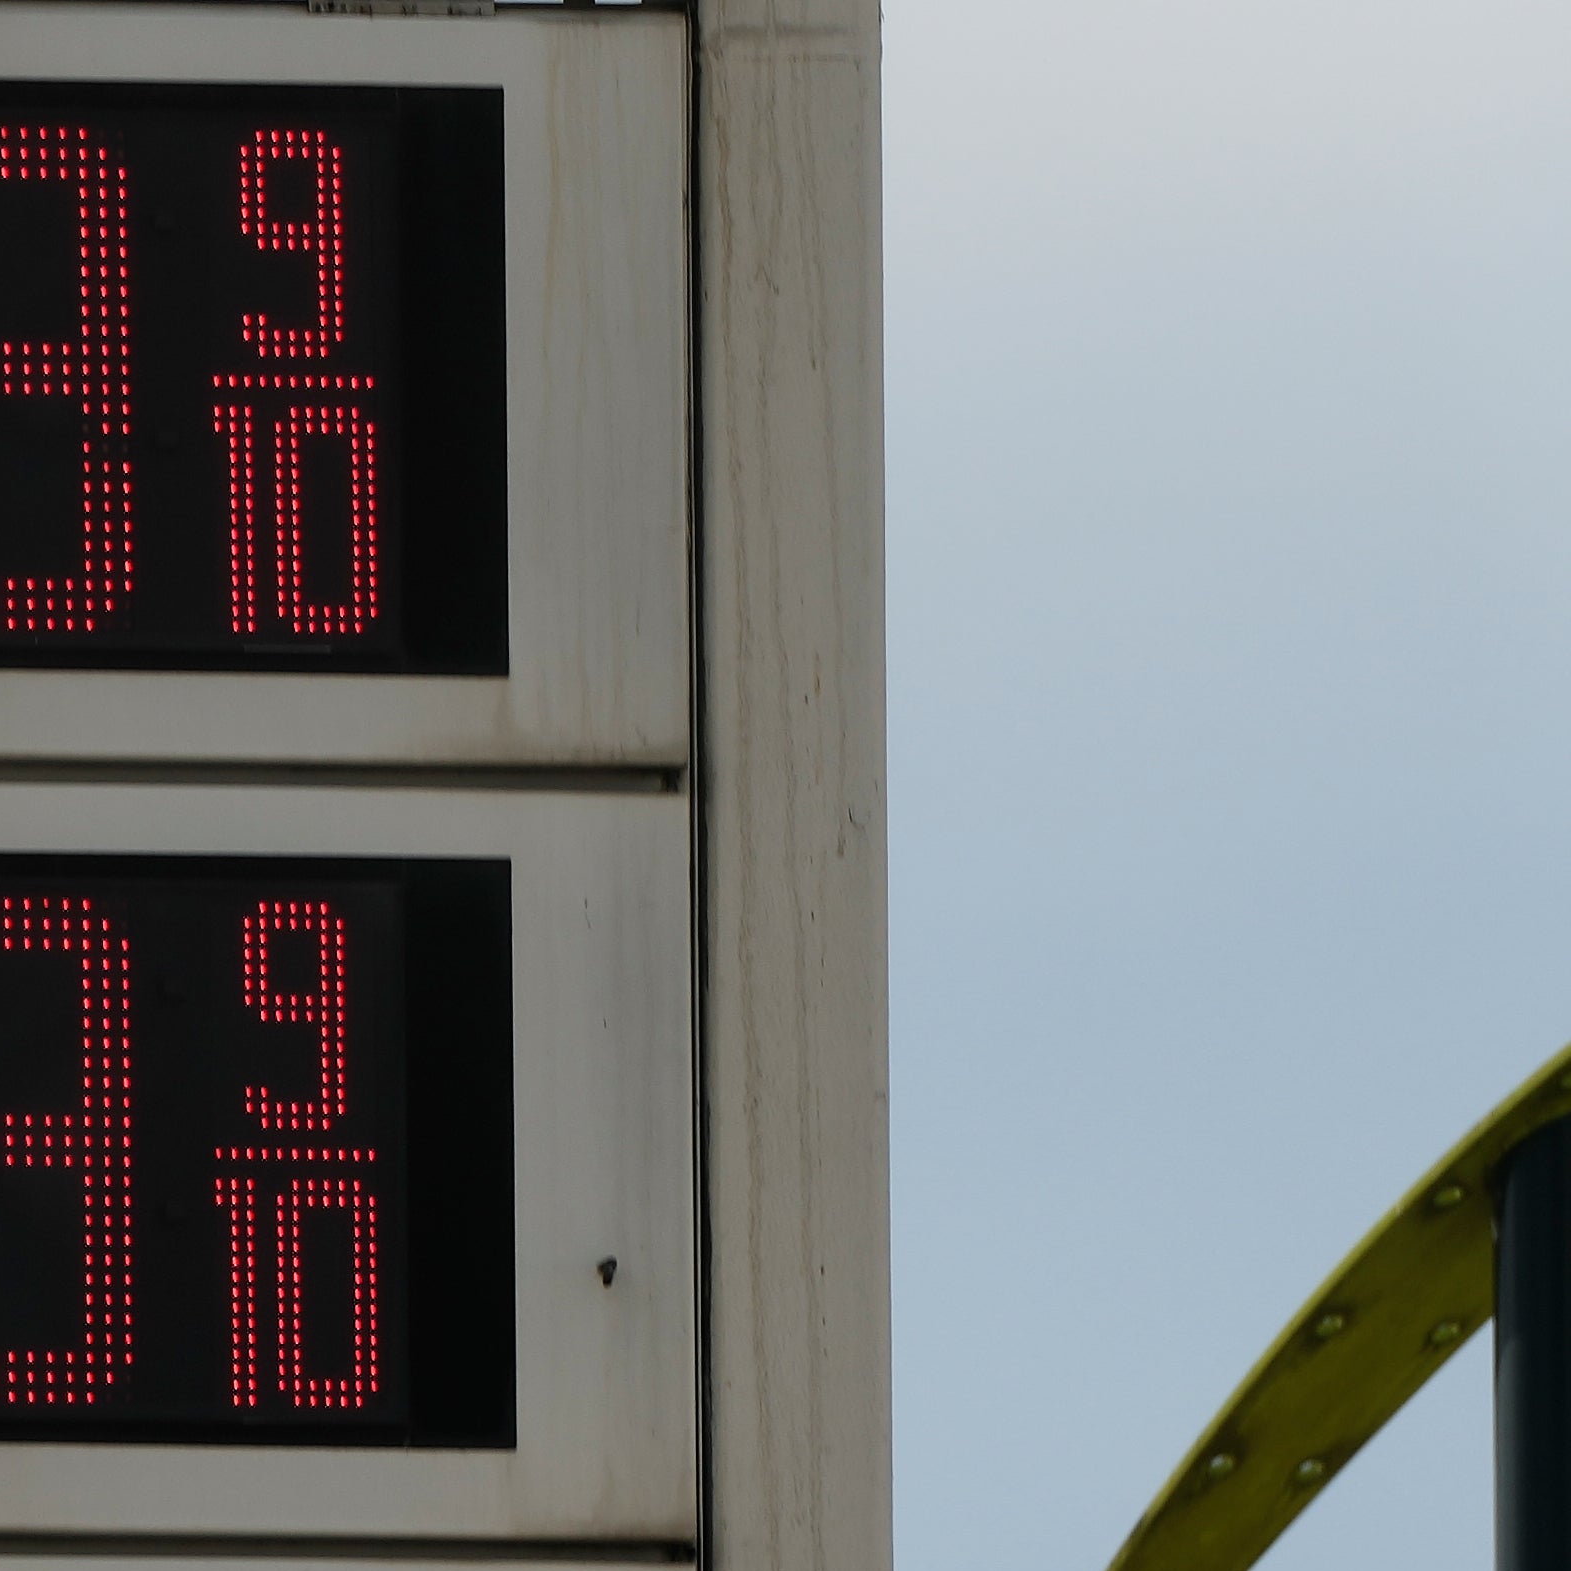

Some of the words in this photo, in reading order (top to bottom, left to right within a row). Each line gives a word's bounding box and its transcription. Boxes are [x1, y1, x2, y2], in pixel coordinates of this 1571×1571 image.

[238, 128, 347, 360] 9
[210, 403, 381, 637] 10
[241, 899, 349, 1133] 9
[212, 1175, 382, 1411] 10
